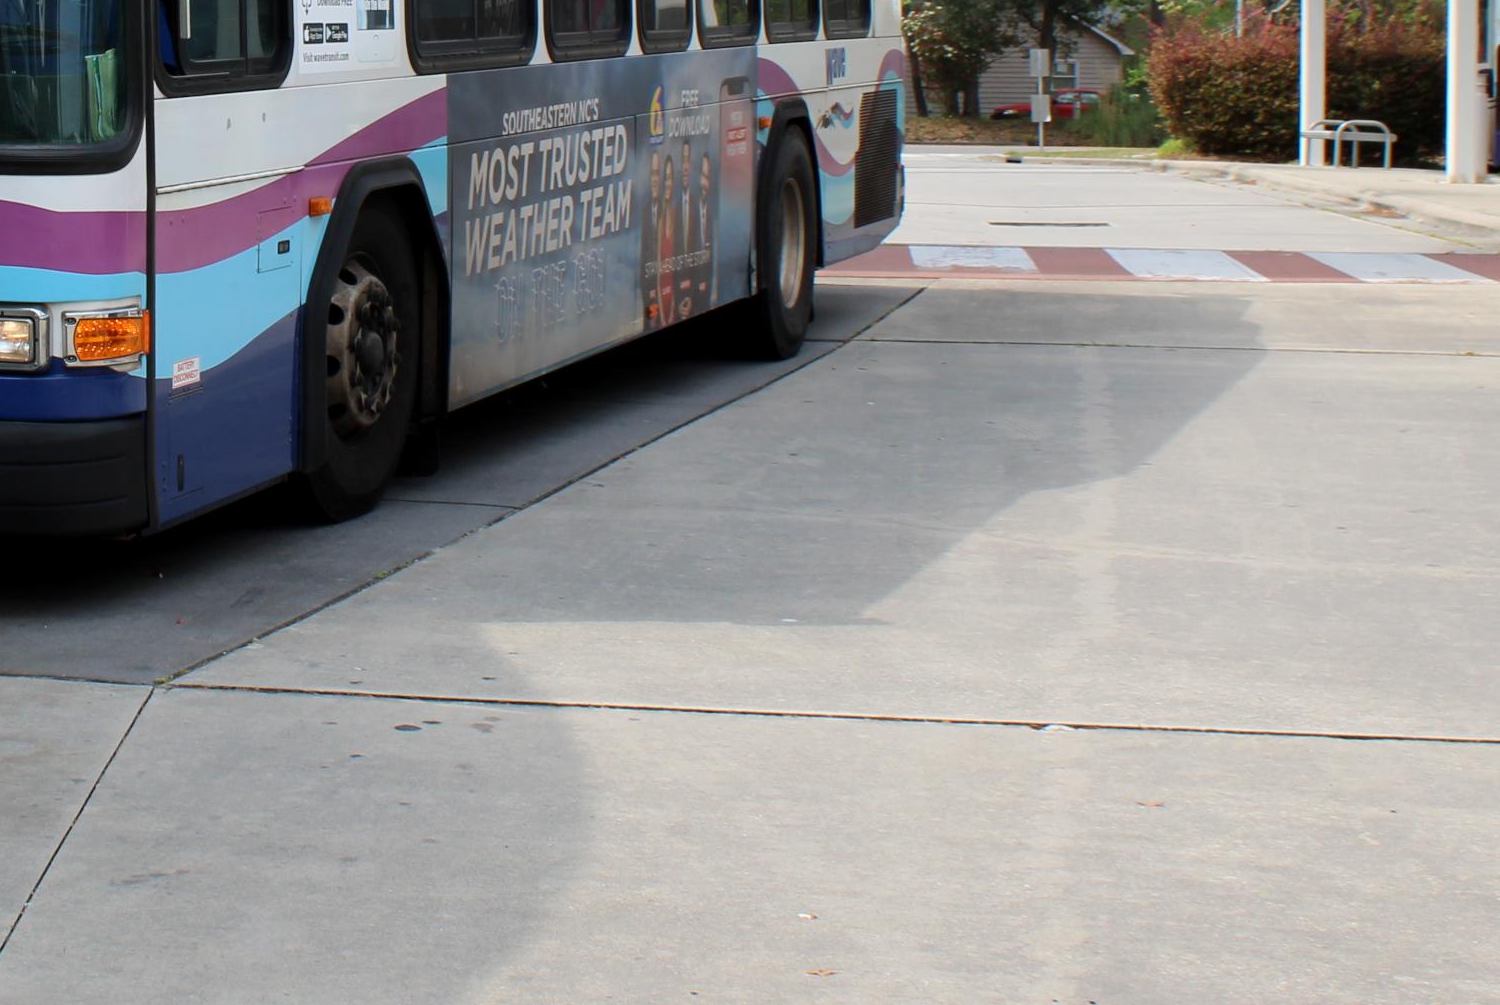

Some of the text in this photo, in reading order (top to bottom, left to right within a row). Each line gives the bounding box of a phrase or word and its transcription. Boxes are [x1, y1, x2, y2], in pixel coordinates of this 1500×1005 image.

[502, 97, 600, 136] SOUTHEASTERN NC'S
[681, 89, 699, 108] FREE
[668, 114, 711, 138] DOWNLOAD
[467, 124, 628, 211] MOST TRUSTED
[465, 179, 633, 277] WEATHER TEAM
